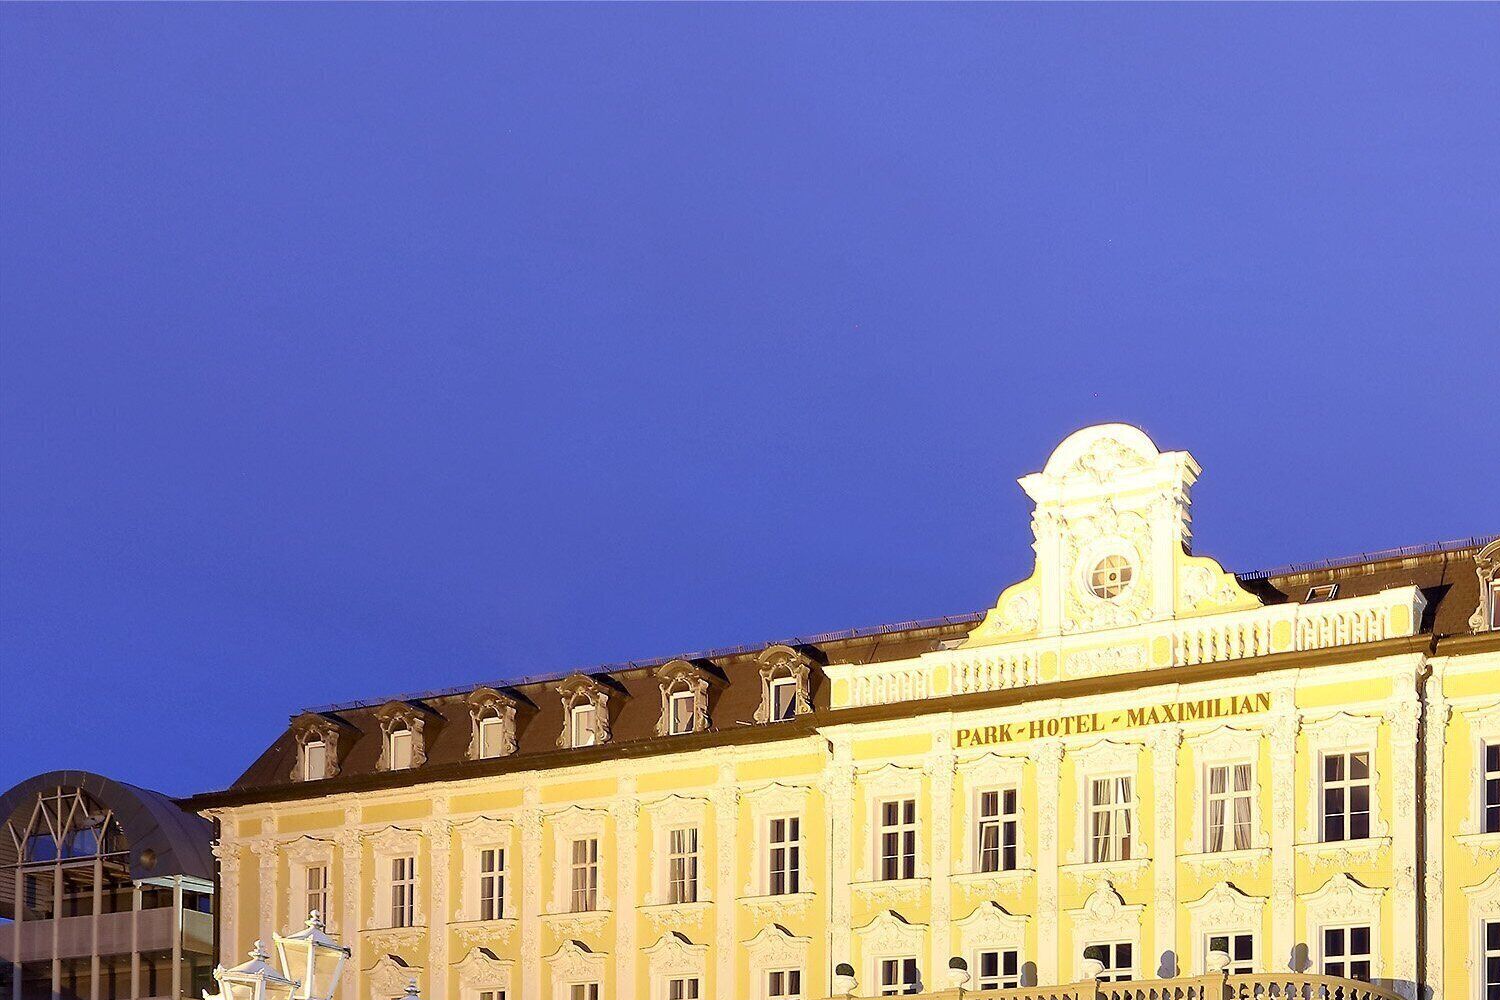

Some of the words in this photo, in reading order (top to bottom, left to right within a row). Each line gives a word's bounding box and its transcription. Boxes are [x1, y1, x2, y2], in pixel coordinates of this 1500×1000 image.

[956, 724, 1013, 748] PARK
[1029, 713, 1105, 739] HOTEL
[1126, 692, 1273, 728] MAXIMILIAN
